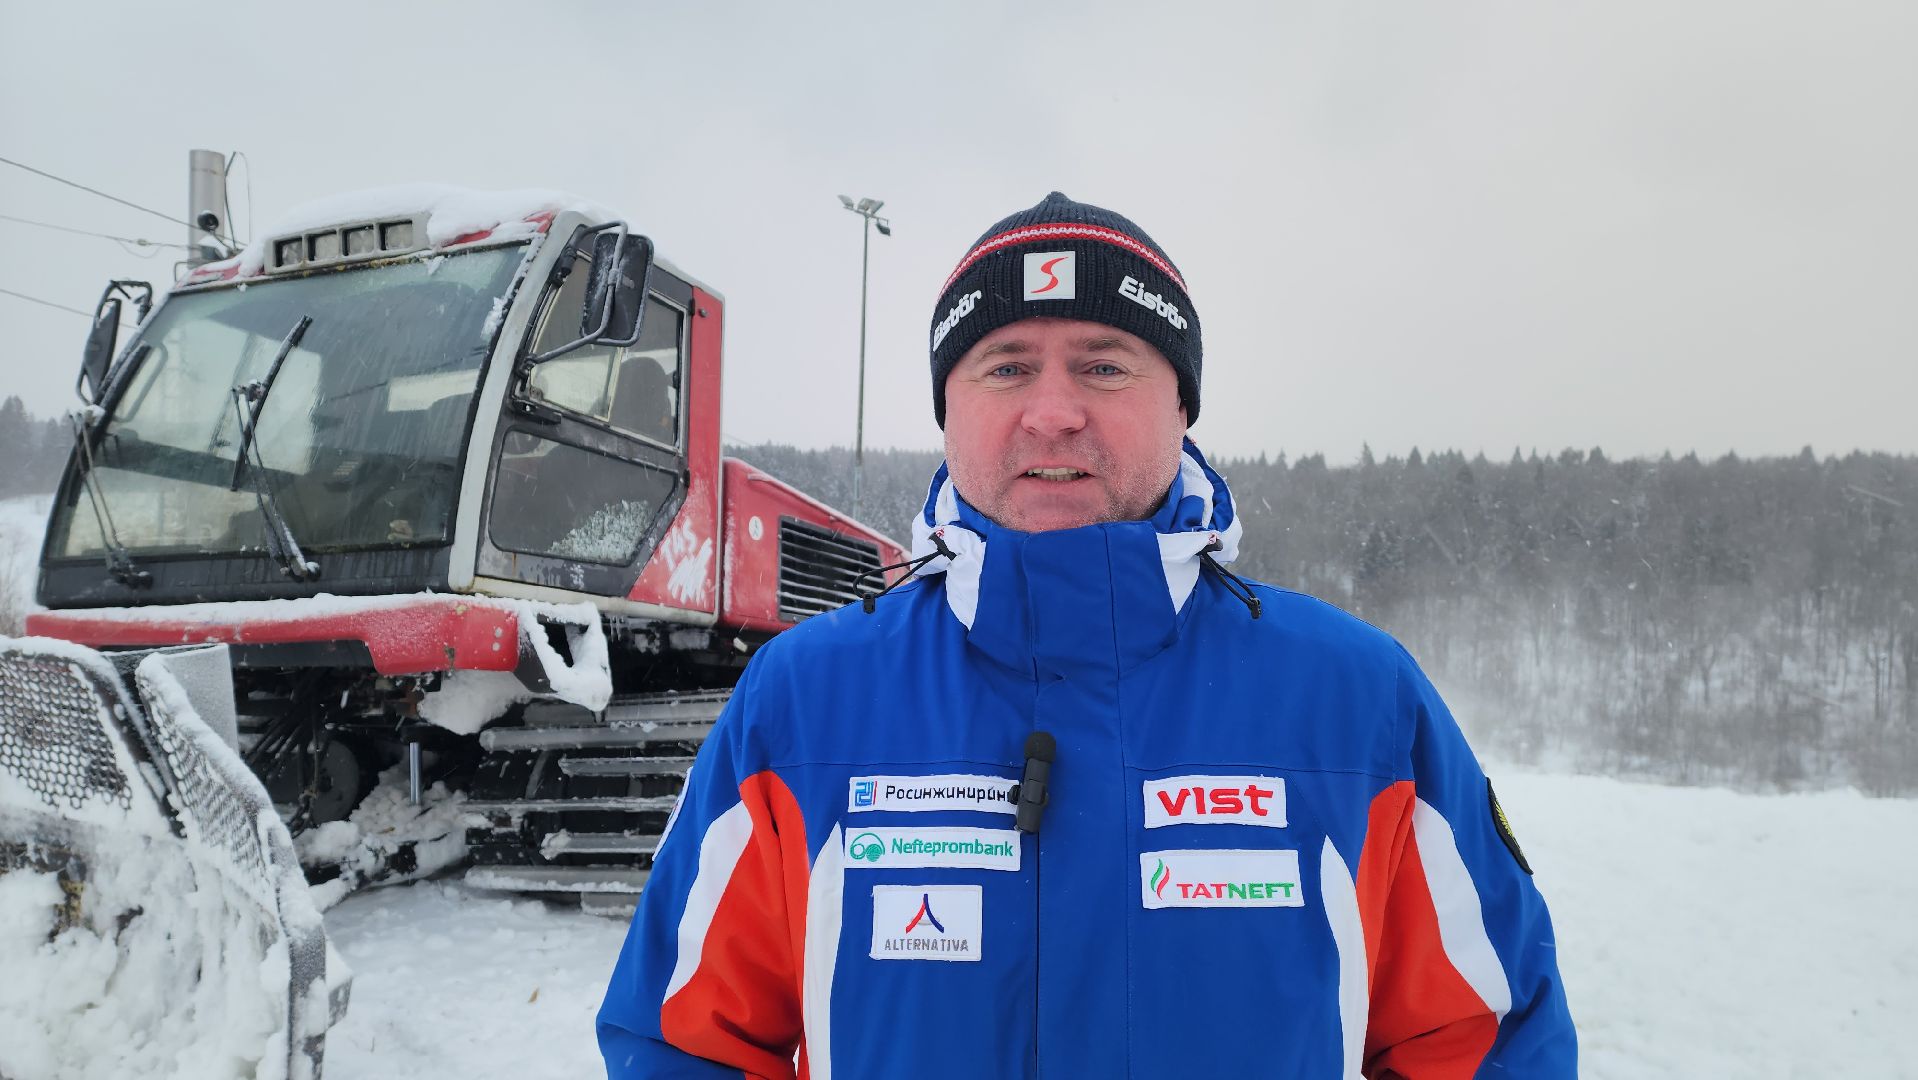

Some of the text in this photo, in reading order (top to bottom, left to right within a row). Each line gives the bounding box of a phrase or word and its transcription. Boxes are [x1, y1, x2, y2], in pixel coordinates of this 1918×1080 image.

[1117, 275, 1188, 330] Eisbär
[885, 785, 1009, 803] Росинжинирин
[891, 837, 1014, 857] Nefteprombank
[1176, 883, 1295, 899] TATNEFT
[884, 938, 969, 952] ALTERNATIVA
